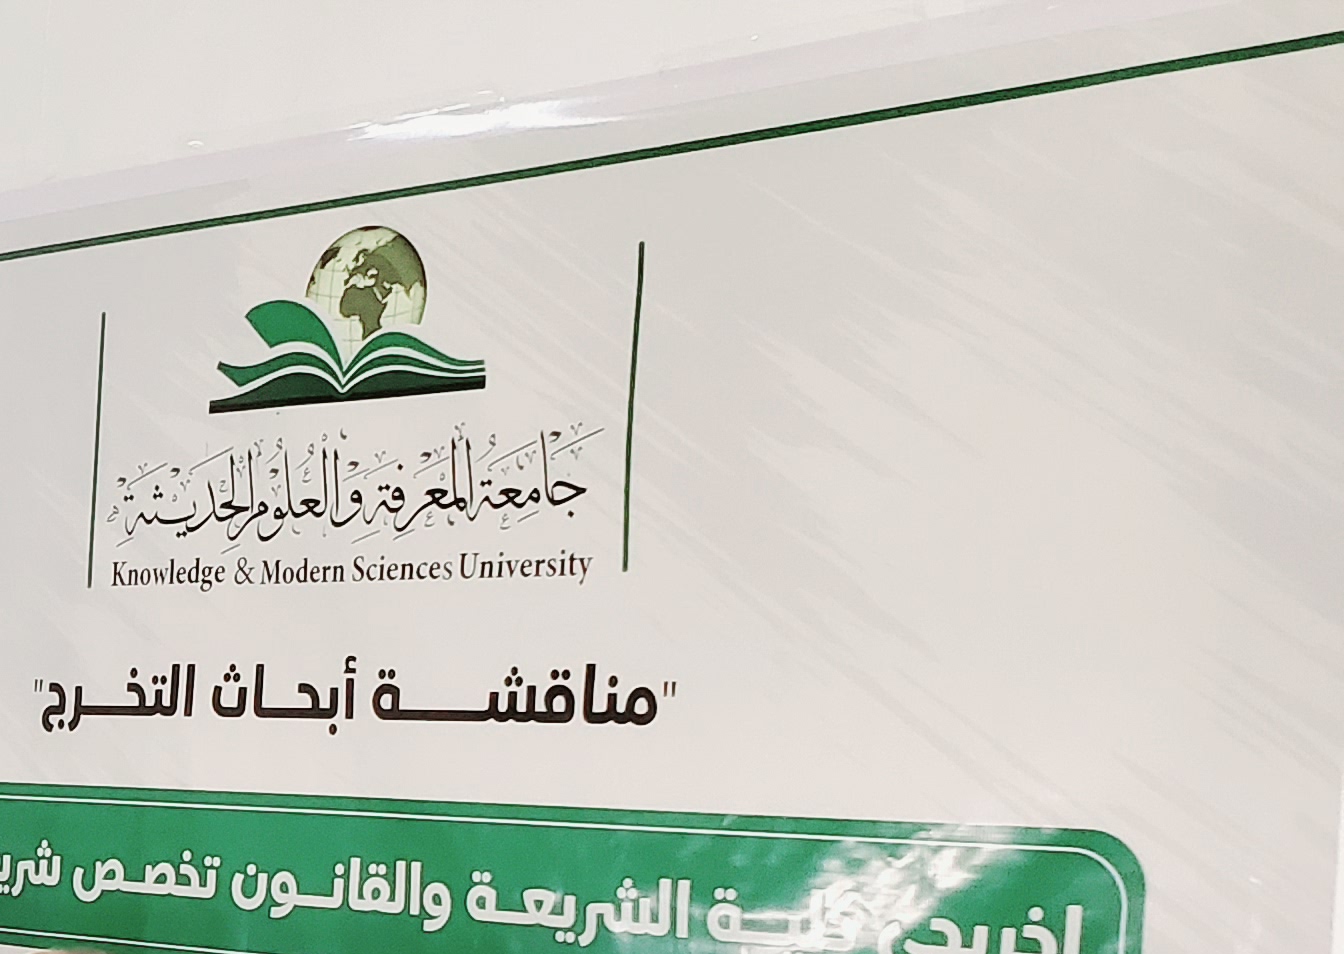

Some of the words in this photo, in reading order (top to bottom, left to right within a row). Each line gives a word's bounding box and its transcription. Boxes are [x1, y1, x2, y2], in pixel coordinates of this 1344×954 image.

[111, 556, 226, 592] Knowledge
[234, 556, 255, 585] &
[261, 557, 345, 585] Modern
[351, 555, 453, 583] Sciences
[459, 549, 594, 586] University
[212, 655, 357, 735] أبحاث
[72, 849, 221, 902] تخصص
[231, 857, 452, 932] والقانون
[466, 870, 691, 947] الشريعة
